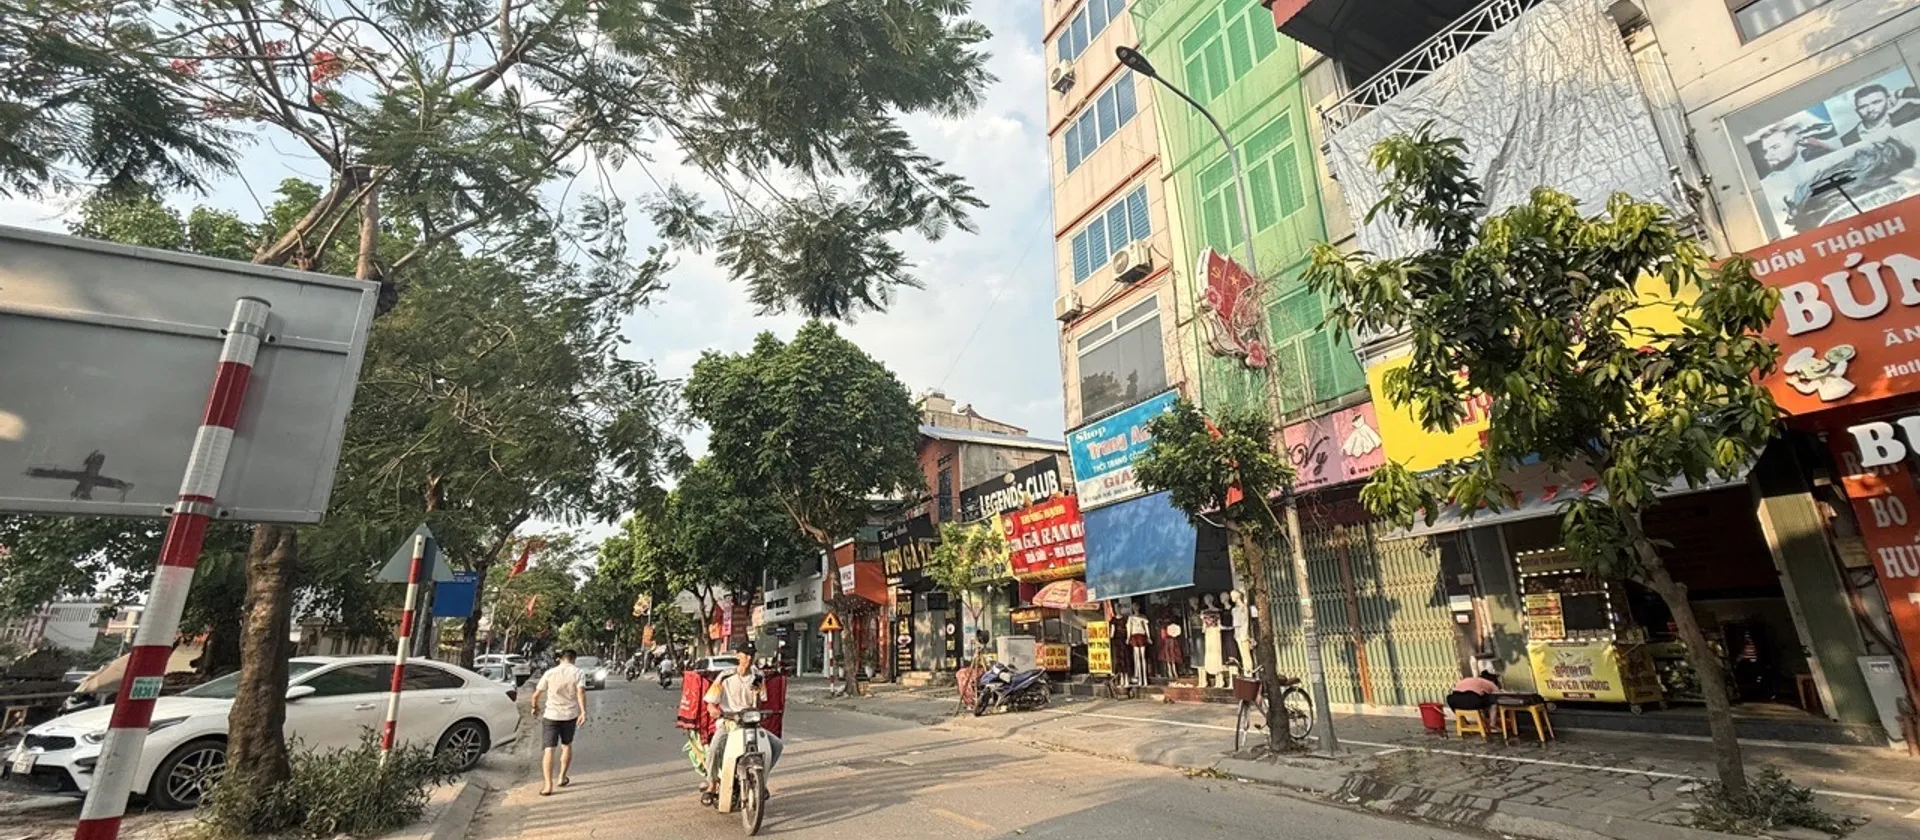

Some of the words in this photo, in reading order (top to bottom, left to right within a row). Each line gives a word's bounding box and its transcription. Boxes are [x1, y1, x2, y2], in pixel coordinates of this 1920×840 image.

[1753, 248, 1806, 277] UẤN
[1811, 216, 1906, 257] THÀNH
[1076, 426, 1106, 443] Shop
[1086, 433, 1128, 460] Trang
[979, 482, 1025, 517] LEGENDS
[1025, 468, 1059, 502] CLUB
[1868, 486, 1908, 528] BÒ
[903, 536, 921, 571] GÀ
